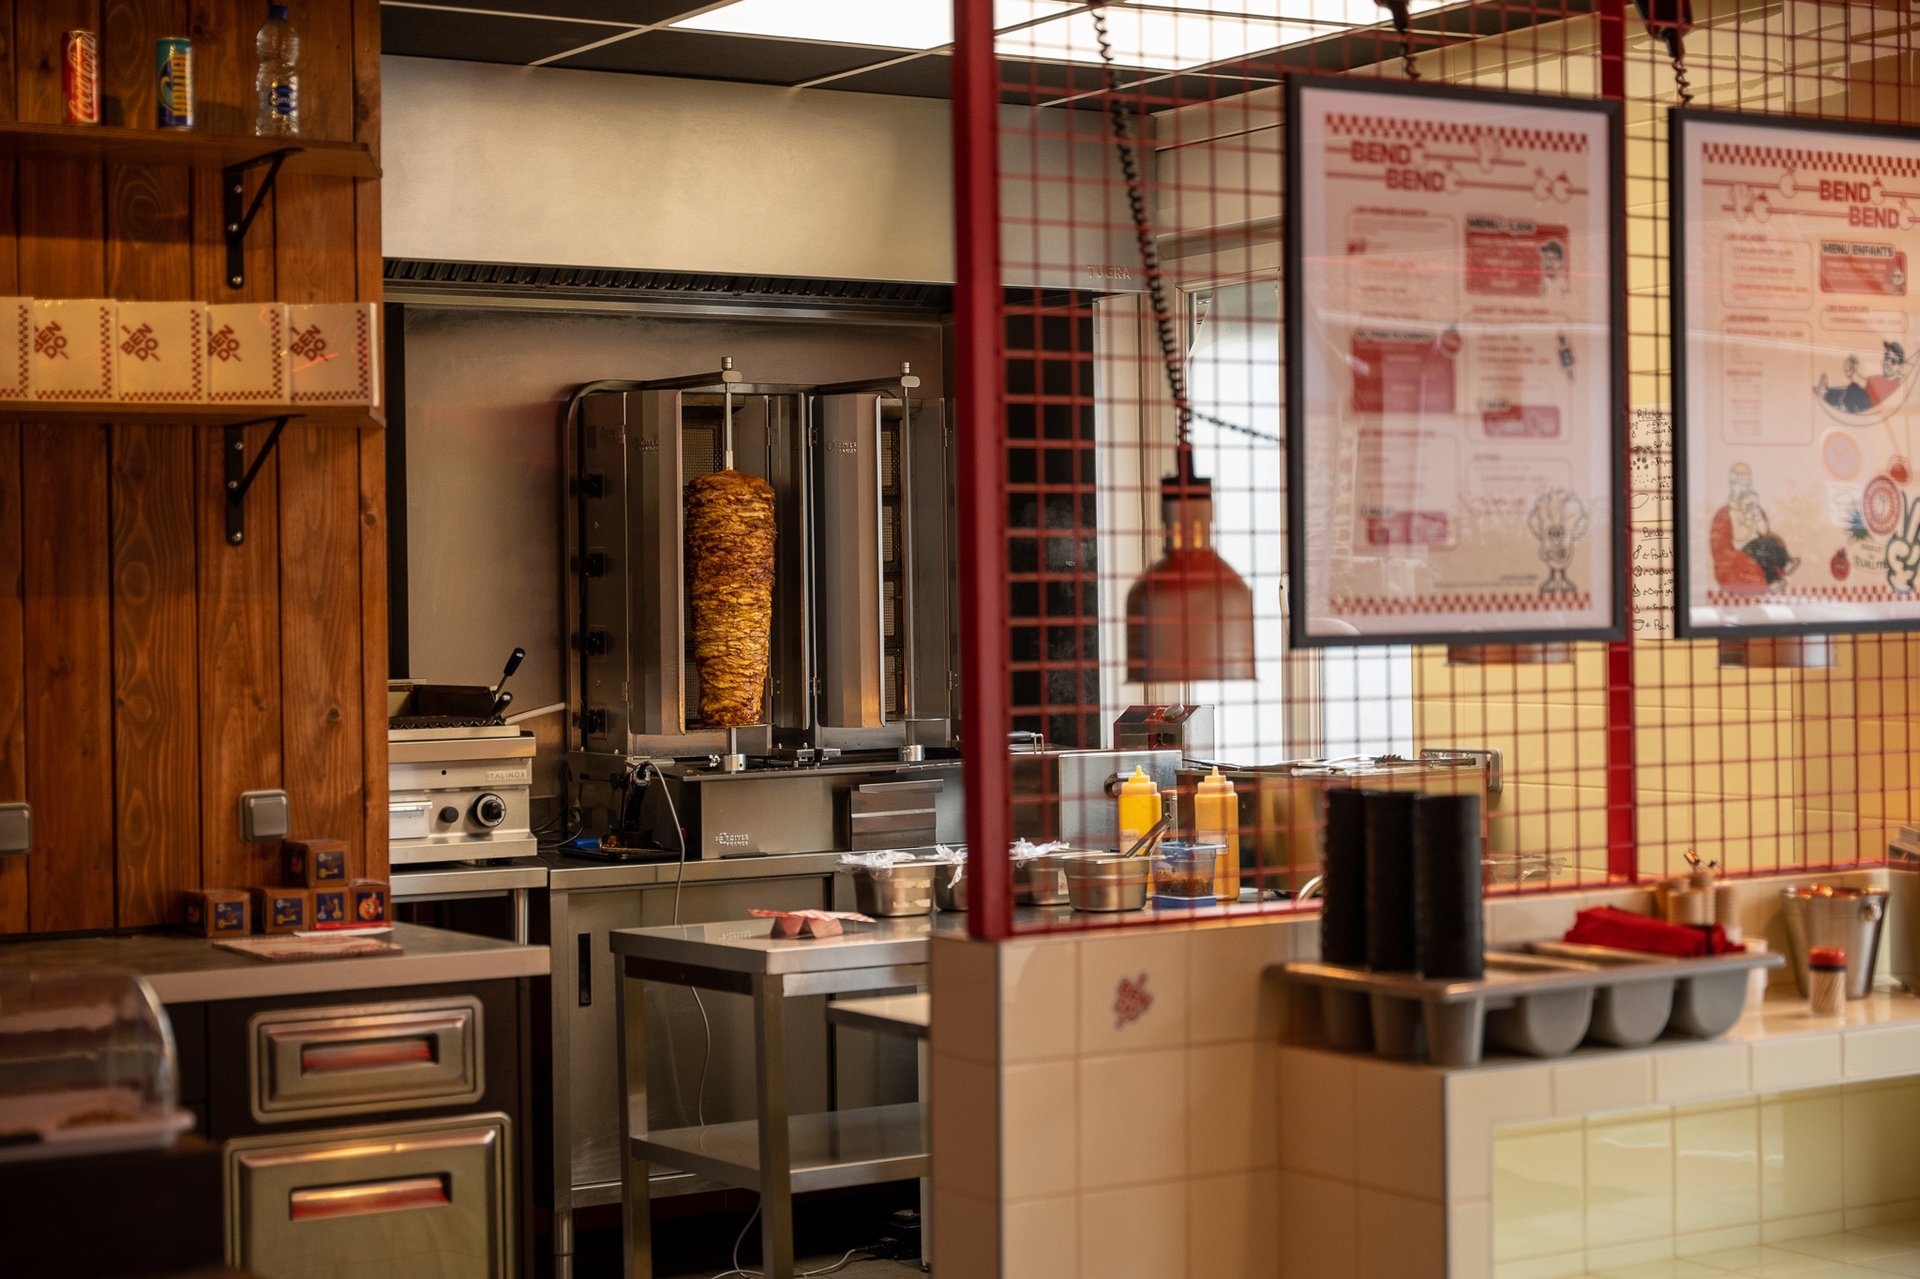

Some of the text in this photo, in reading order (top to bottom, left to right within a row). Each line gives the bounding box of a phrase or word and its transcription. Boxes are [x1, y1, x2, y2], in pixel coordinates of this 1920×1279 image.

[1823, 243, 1849, 254] MENU
[44, 335, 68, 360] DO
[120, 322, 153, 356] BEN
[134, 337, 159, 362] DO
[216, 338, 240, 362] DO
[290, 323, 321, 357] BEN
[304, 338, 327, 362] DO
